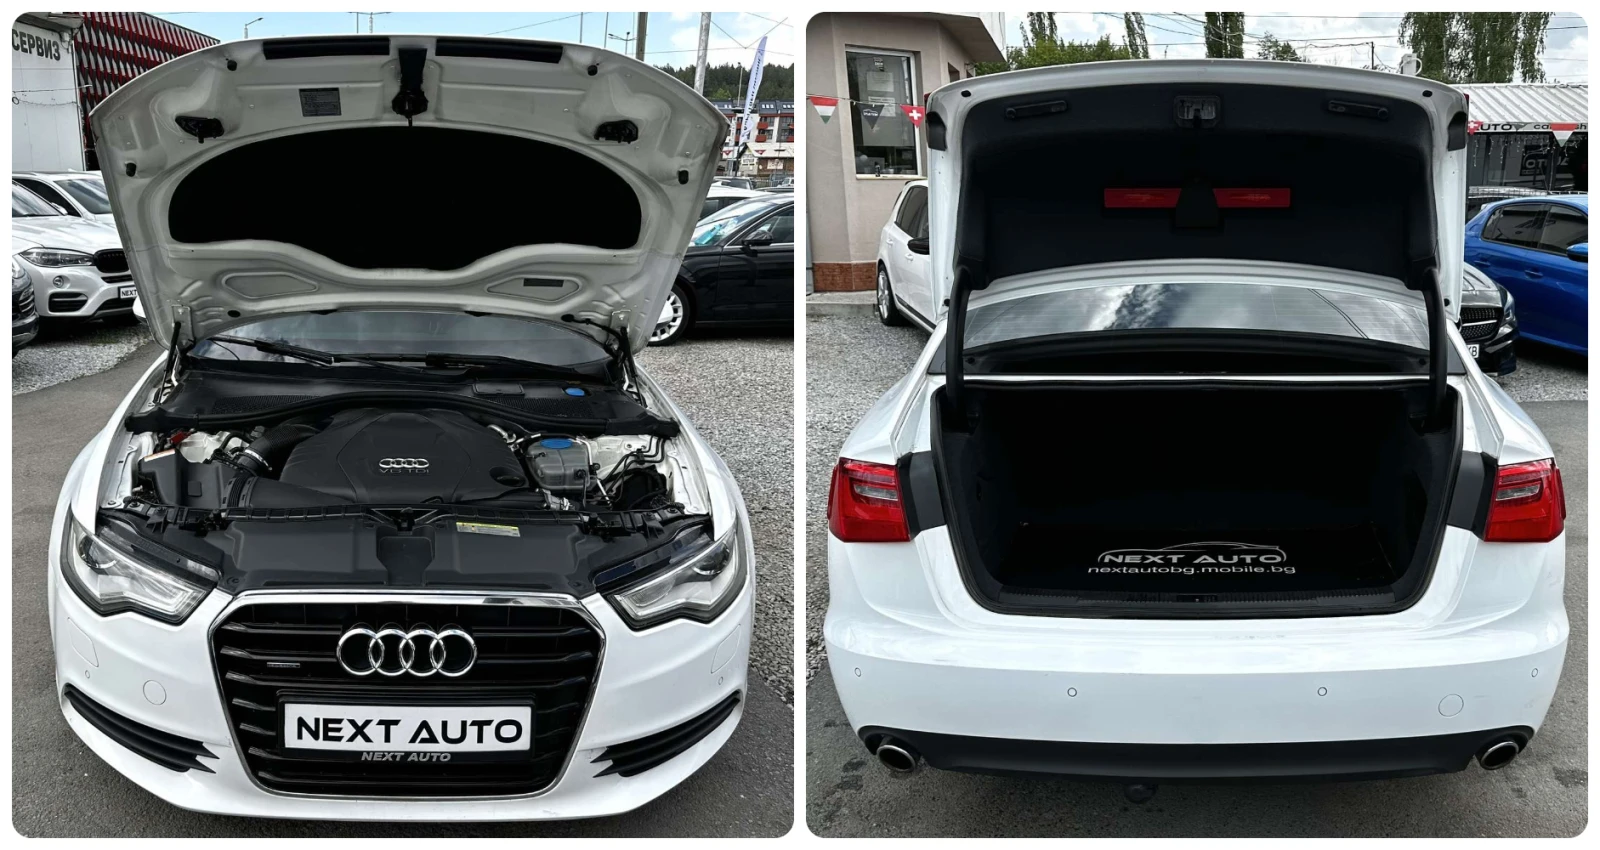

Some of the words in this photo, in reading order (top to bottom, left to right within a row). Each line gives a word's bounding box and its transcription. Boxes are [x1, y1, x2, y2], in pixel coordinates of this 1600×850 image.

[12, 28, 61, 61] СЕРВИЗ
[1476, 123, 1512, 131] UTO
[121, 289, 137, 297] NEXT
[1103, 554, 1186, 564] NEXT
[1192, 554, 1283, 564] AUTO
[1087, 565, 1296, 575] nextautobg.mobile.bg
[297, 716, 401, 743] NEXT
[408, 718, 523, 745] AUTO
[361, 751, 405, 762] NEXT
[407, 752, 451, 762] AUTO
